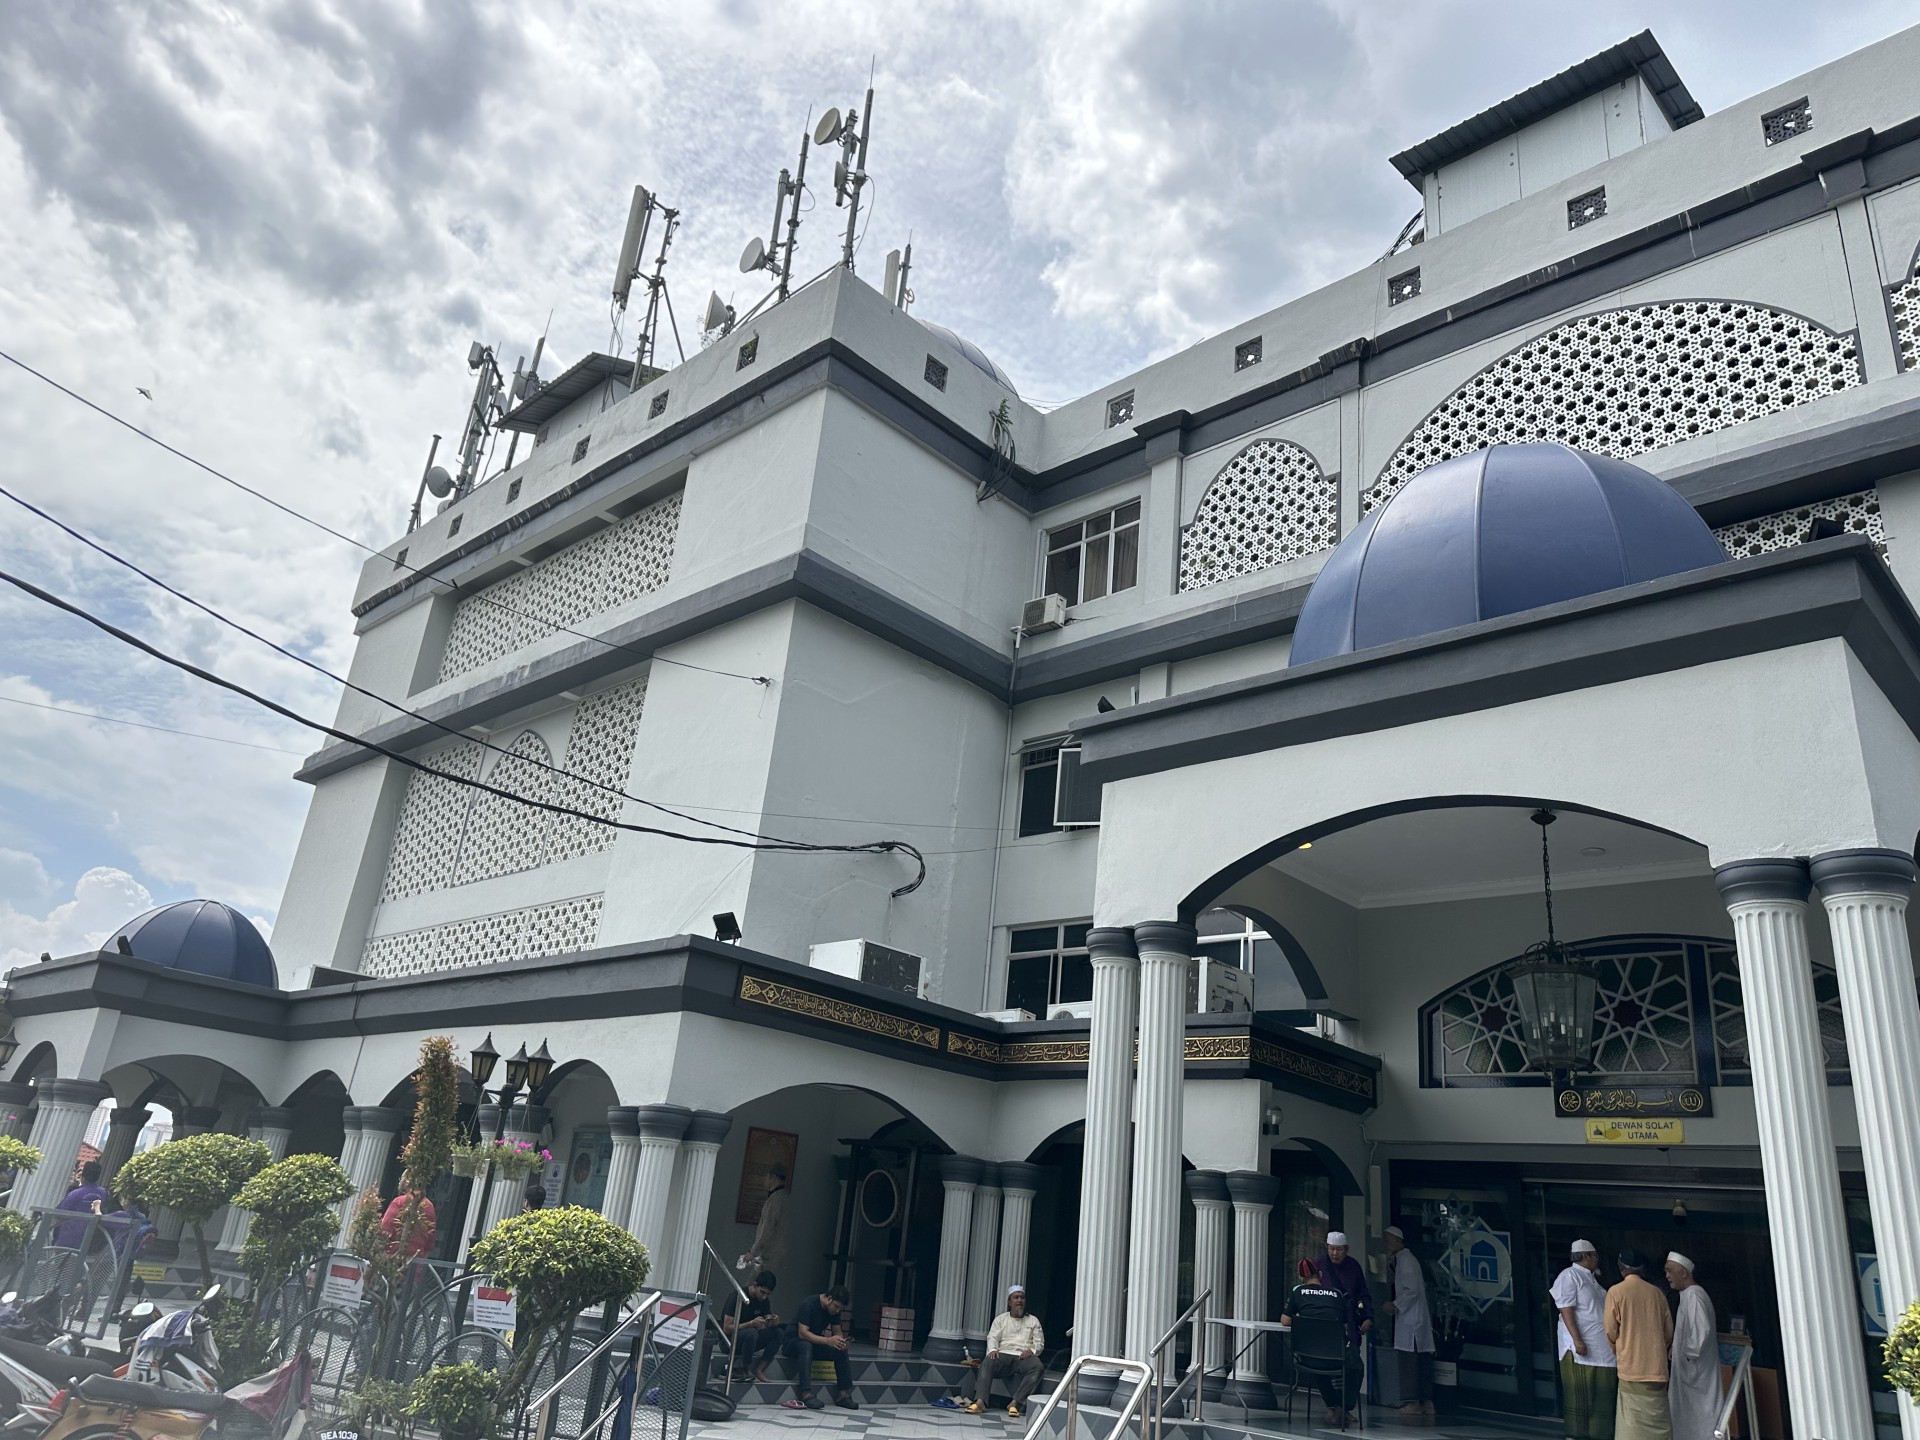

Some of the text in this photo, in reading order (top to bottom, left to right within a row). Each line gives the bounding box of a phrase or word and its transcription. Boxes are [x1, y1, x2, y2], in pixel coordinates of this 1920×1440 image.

[1611, 1121, 1675, 1130] DEWAN SOLAT
[1628, 1131, 1659, 1140] UTAMA
[1301, 1288, 1338, 1298] PETRONAS
